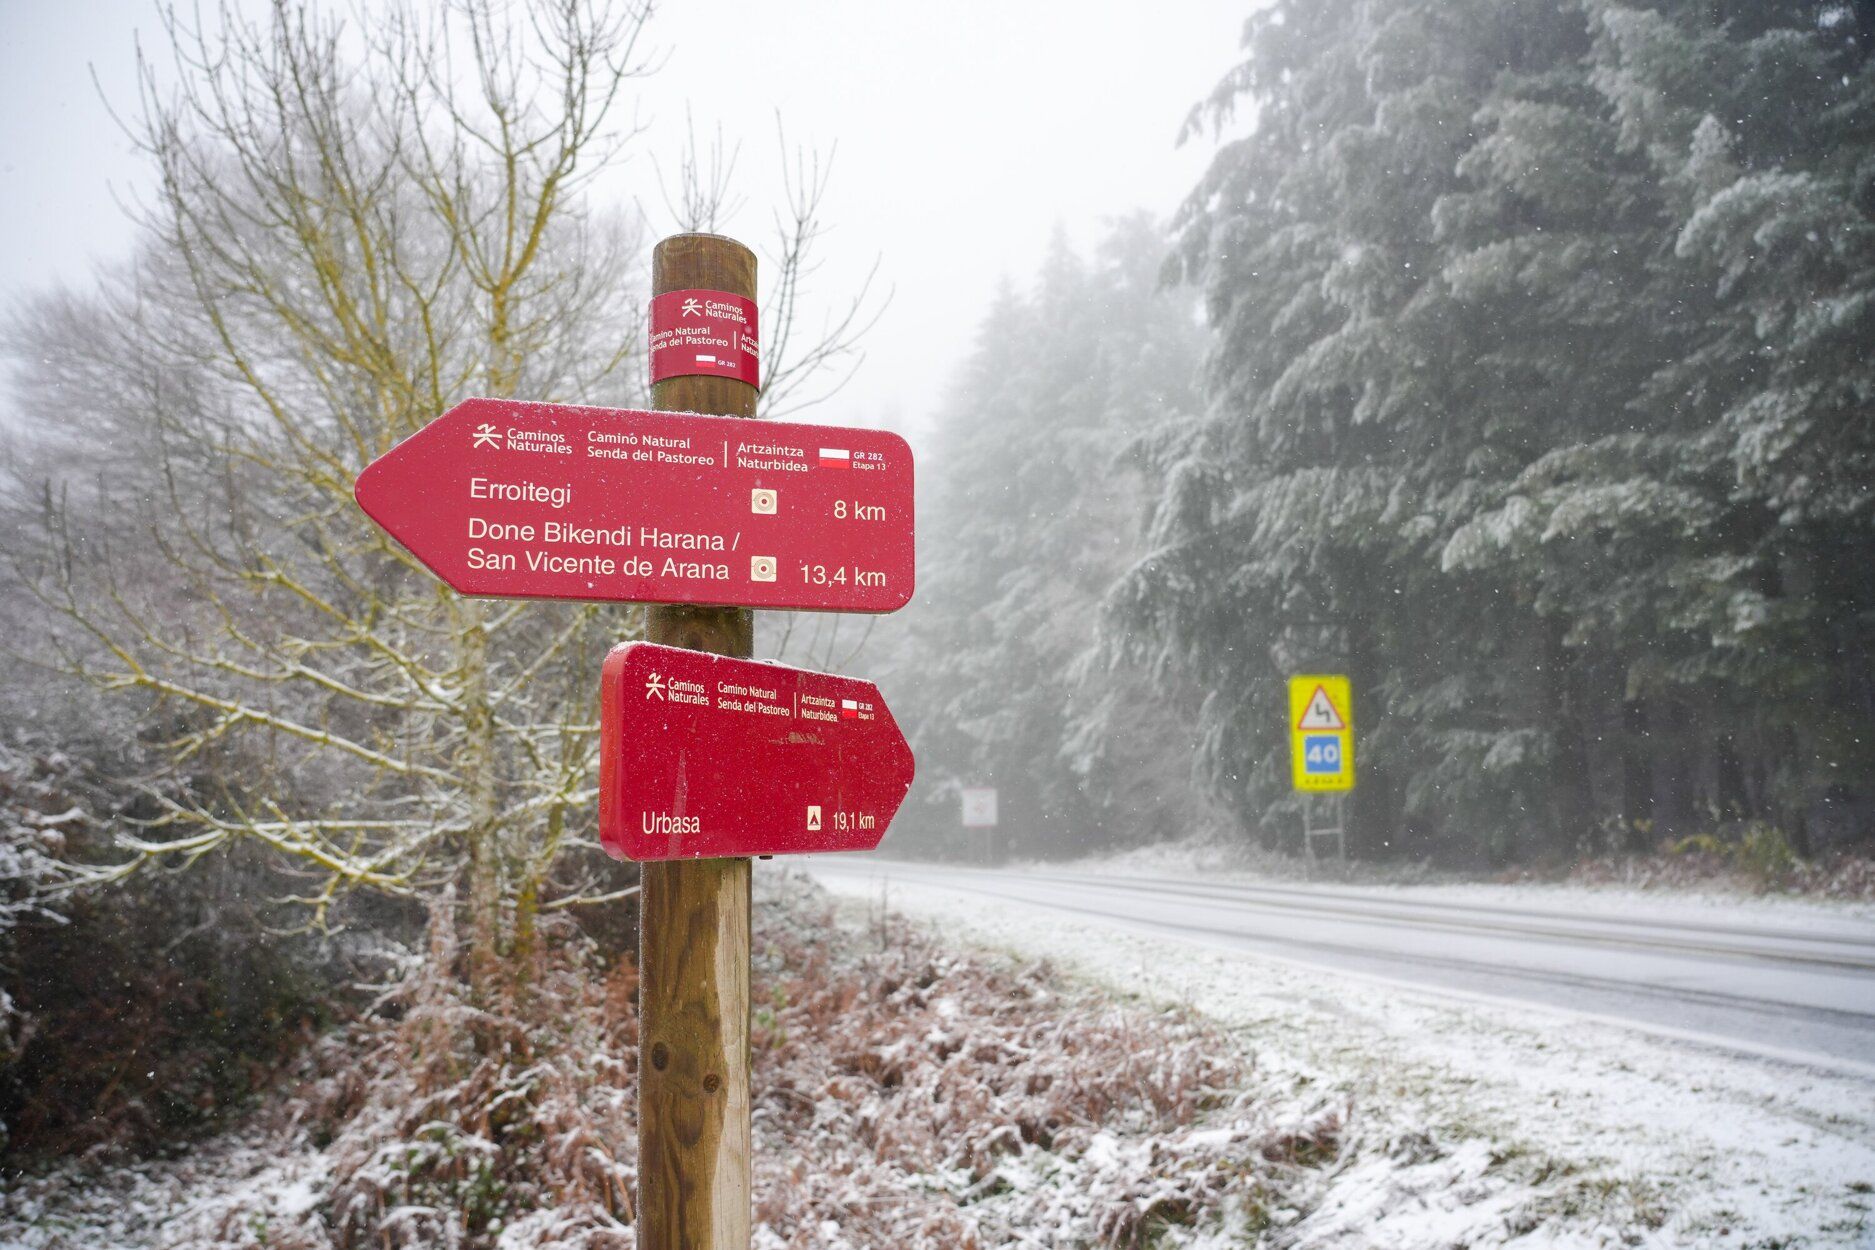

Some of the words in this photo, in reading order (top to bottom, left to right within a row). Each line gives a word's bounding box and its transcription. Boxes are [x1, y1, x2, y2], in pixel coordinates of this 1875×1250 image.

[705, 300, 743, 315] Caminos
[705, 309, 747, 324] Naturales
[650, 330, 673, 343] amino
[675, 326, 710, 335] Natural
[650, 341, 667, 353] enda
[669, 337, 683, 347] del
[686, 336, 728, 347] Pastoreo
[507, 428, 565, 443] Caminos
[587, 430, 638, 445] Camino
[642, 435, 690, 449] Natural
[507, 440, 572, 455] Naturales
[587, 446, 627, 460] Senda
[632, 448, 653, 461] del
[658, 451, 714, 466] Pastoreo
[737, 442, 804, 457] Artzaintza
[853, 451, 865, 459] GR
[867, 452, 883, 461] 282
[737, 457, 808, 473] Naturbidea
[853, 462, 875, 471] Etapa
[876, 463, 886, 471] 13
[470, 477, 572, 509] Erroitegi
[834, 500, 847, 519] 8
[854, 501, 886, 520] km
[468, 517, 535, 542] Done
[543, 521, 632, 547] Bikendi
[640, 528, 725, 552] Harana
[731, 531, 741, 552] /
[467, 547, 516, 571] San
[525, 551, 615, 576] Vicente
[623, 555, 653, 577] de
[660, 558, 730, 580] Arana
[800, 565, 847, 588] 13,4
[853, 566, 886, 587] km
[668, 676, 705, 694] Caminos
[717, 681, 748, 696] Camino
[749, 687, 777, 700] Natural
[668, 690, 710, 706] Naturales
[801, 693, 836, 709] Artzaintza
[717, 697, 742, 711] Senda
[744, 700, 756, 713] del
[758, 702, 790, 717] Pastoreo
[801, 709, 838, 722] Naturbidea
[1307, 744, 1338, 764] 40
[643, 811, 701, 834] Urbasa
[833, 812, 855, 833] 19,1
[860, 812, 875, 830] km
